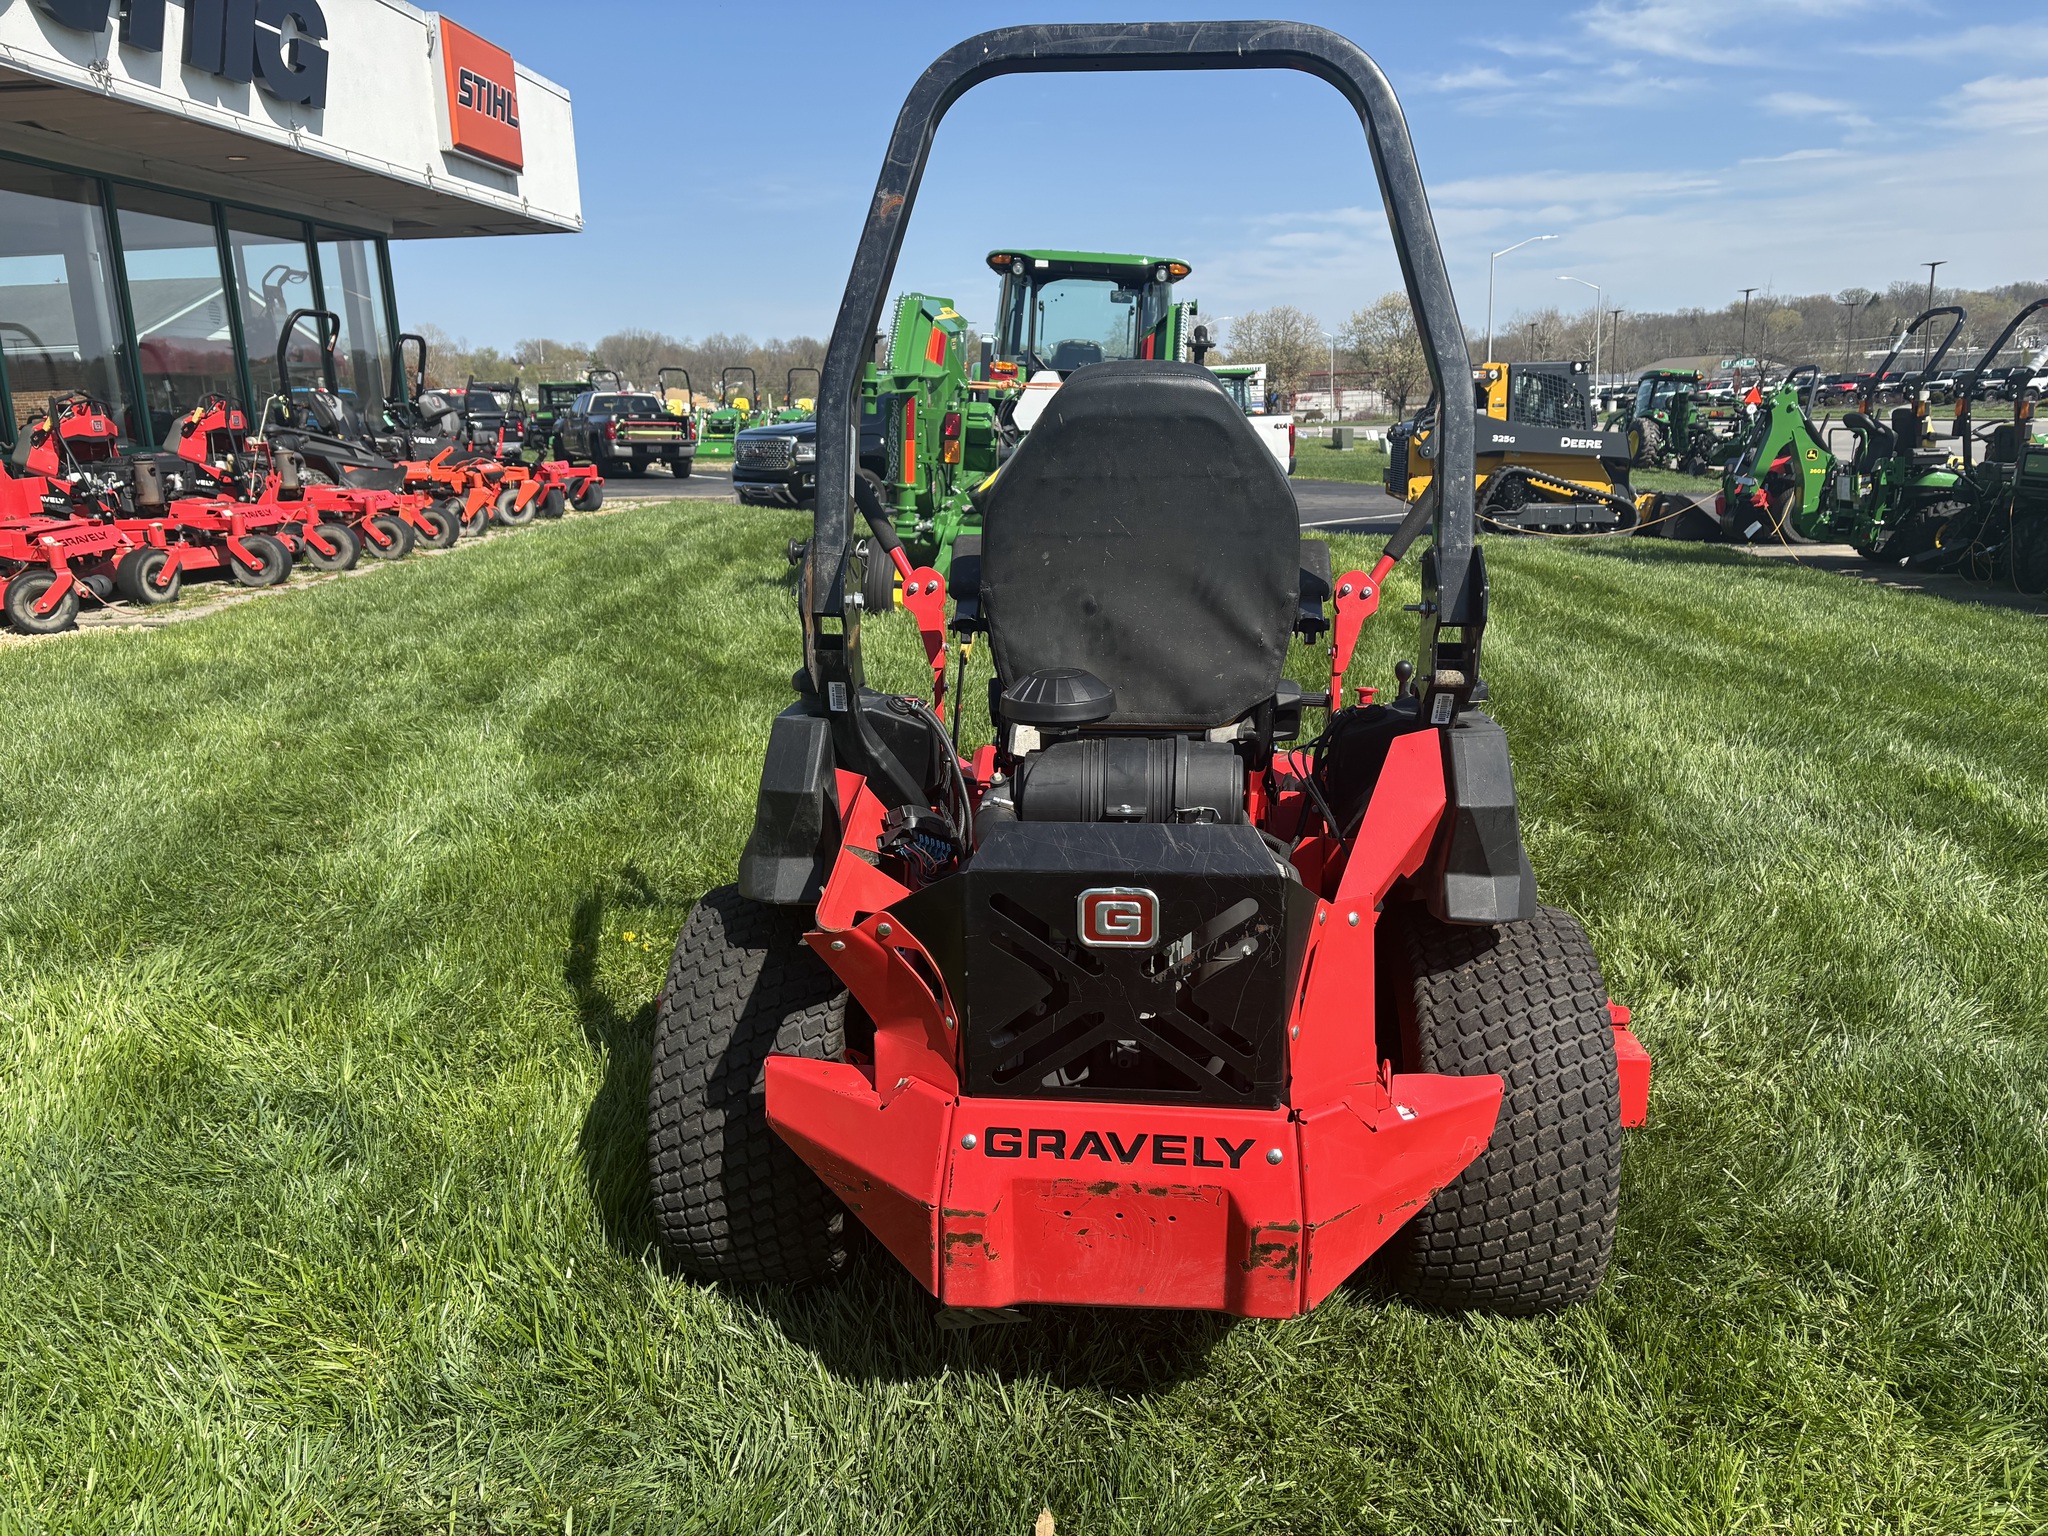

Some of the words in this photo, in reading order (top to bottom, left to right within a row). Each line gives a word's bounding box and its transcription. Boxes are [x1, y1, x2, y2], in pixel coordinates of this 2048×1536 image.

[457, 66, 519, 130] STIHL
[413, 436, 437, 444] VELY
[1560, 436, 1603, 449] DEERE
[195, 479, 215, 487] VELY
[39, 496, 65, 505] AVELY
[984, 1126, 1257, 1170] GRAVELY
